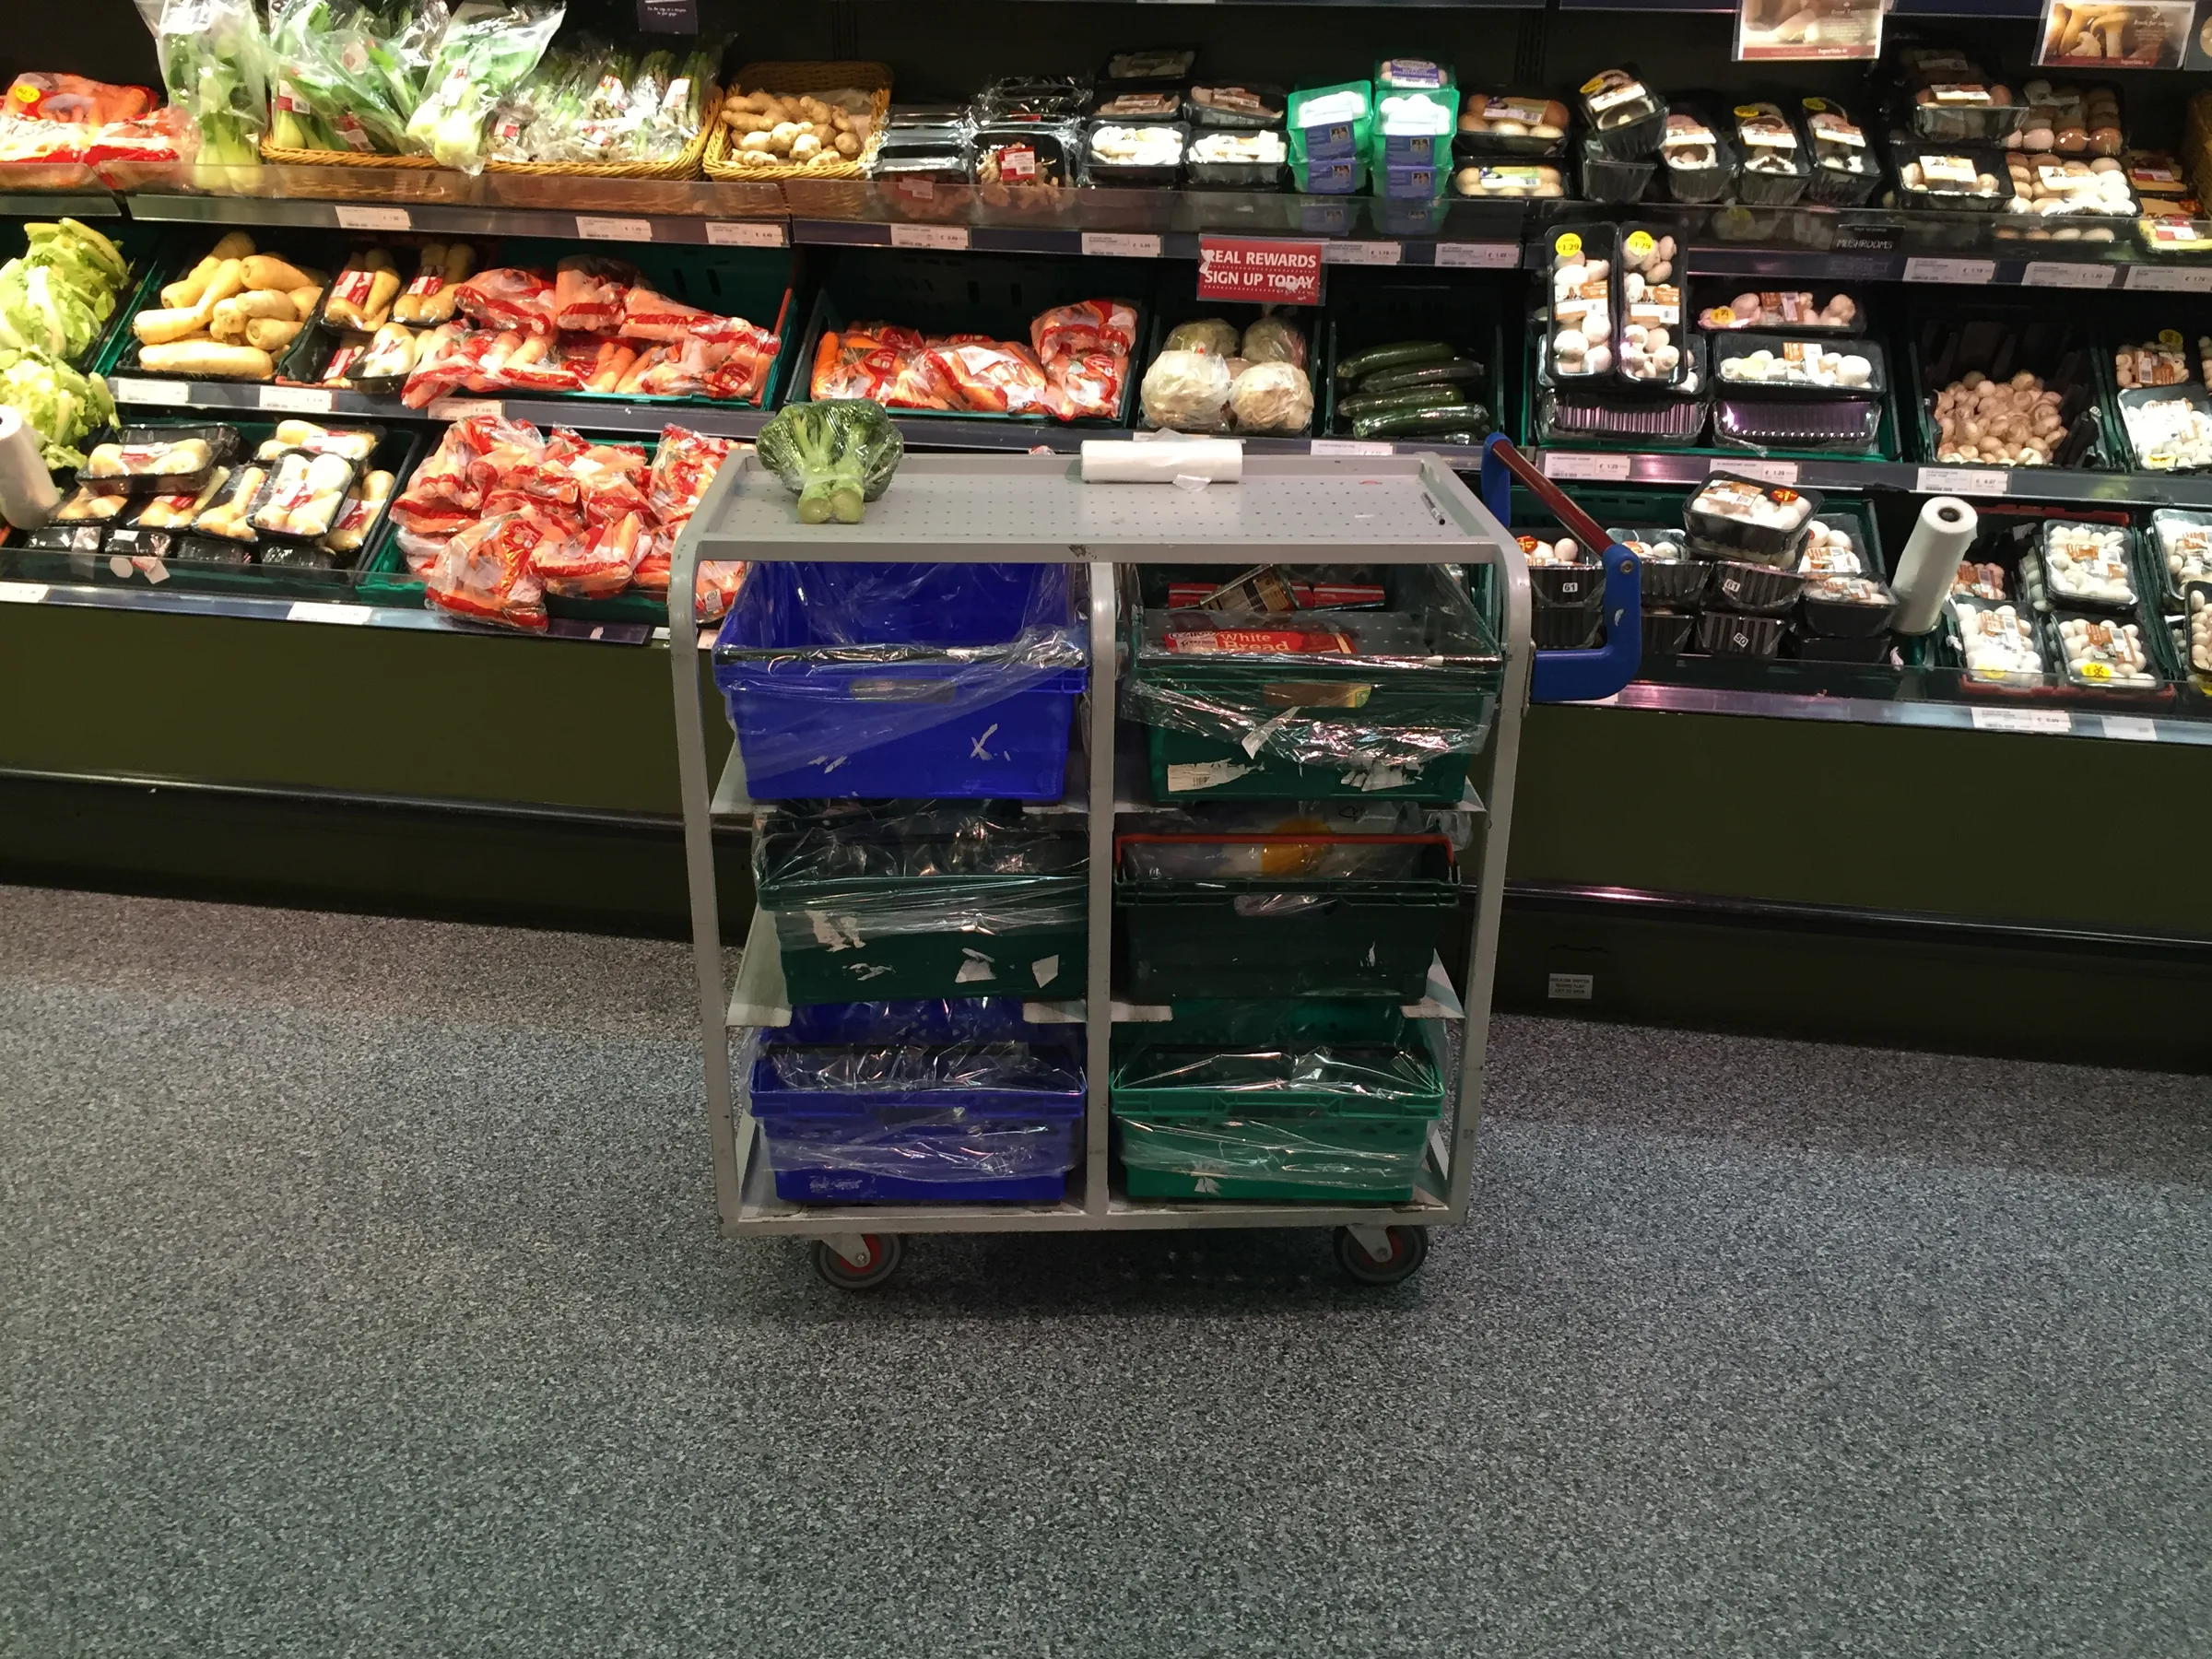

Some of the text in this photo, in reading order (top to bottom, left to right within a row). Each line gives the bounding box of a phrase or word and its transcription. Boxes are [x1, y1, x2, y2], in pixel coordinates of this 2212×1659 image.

[1836, 239, 1893, 250] MUSHROOMS
[1206, 249, 1241, 265] REAL
[1246, 252, 1317, 268] REWARDS
[1205, 270, 1315, 288] SIGN UP TODAY
[1564, 583, 1577, 592] 61
[1220, 632, 1272, 642] White
[1735, 634, 1747, 645] 50
[1223, 641, 1291, 652] Bread
